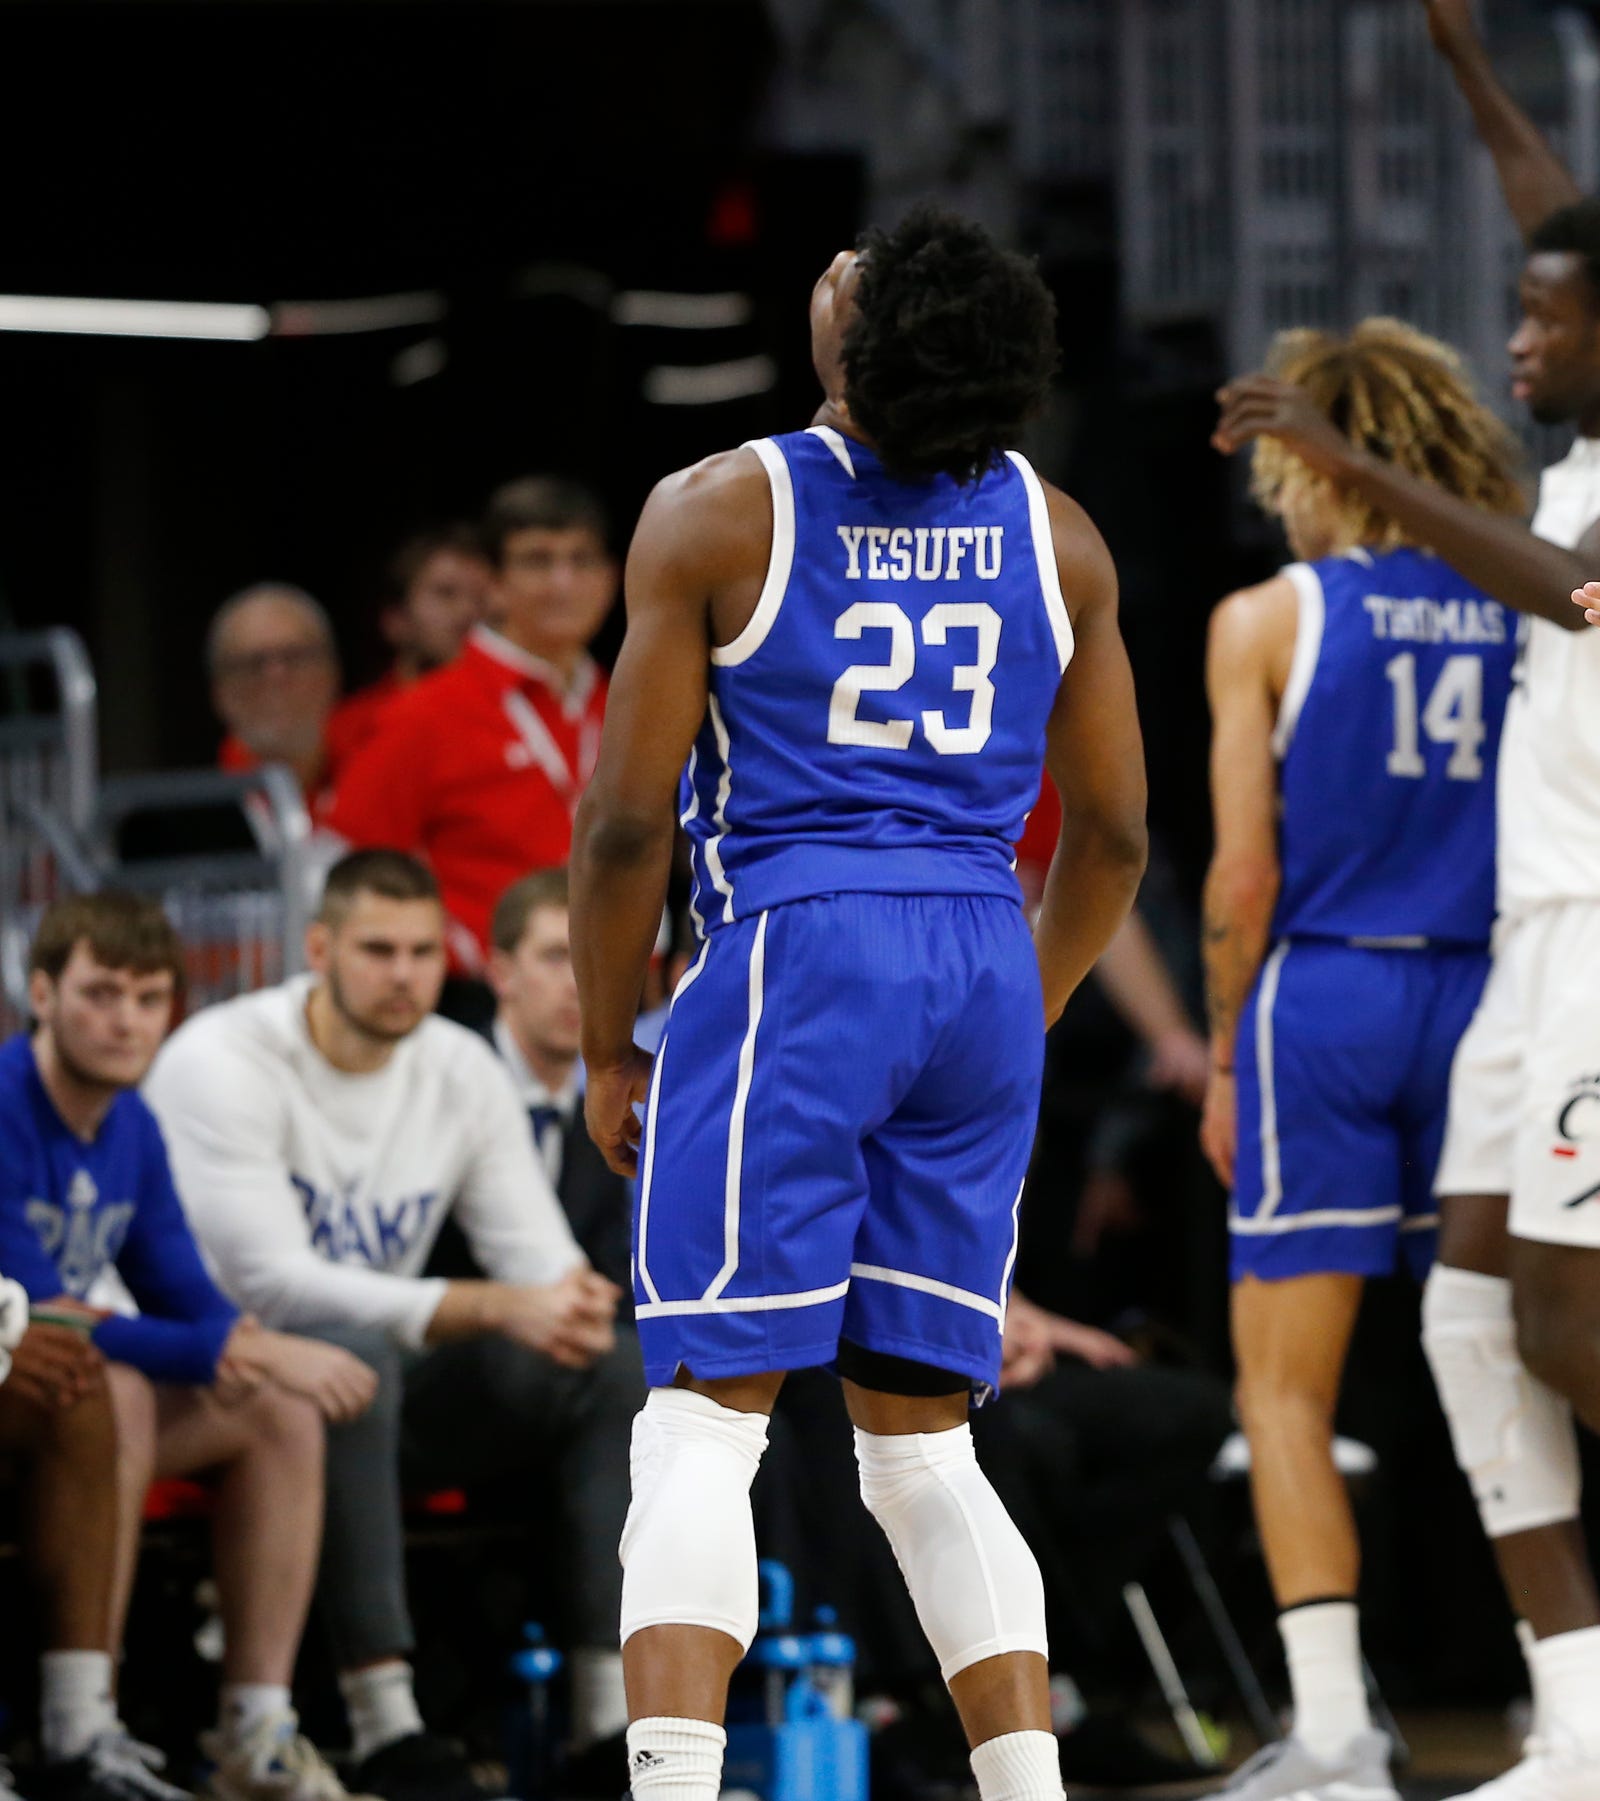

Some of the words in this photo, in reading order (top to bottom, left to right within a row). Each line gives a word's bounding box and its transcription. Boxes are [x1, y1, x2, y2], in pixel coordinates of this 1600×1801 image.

[837, 526, 1004, 581] YESUFU
[1363, 594, 1507, 645] THOMAS
[827, 602, 1003, 755] 23
[1385, 651, 1486, 781] 14
